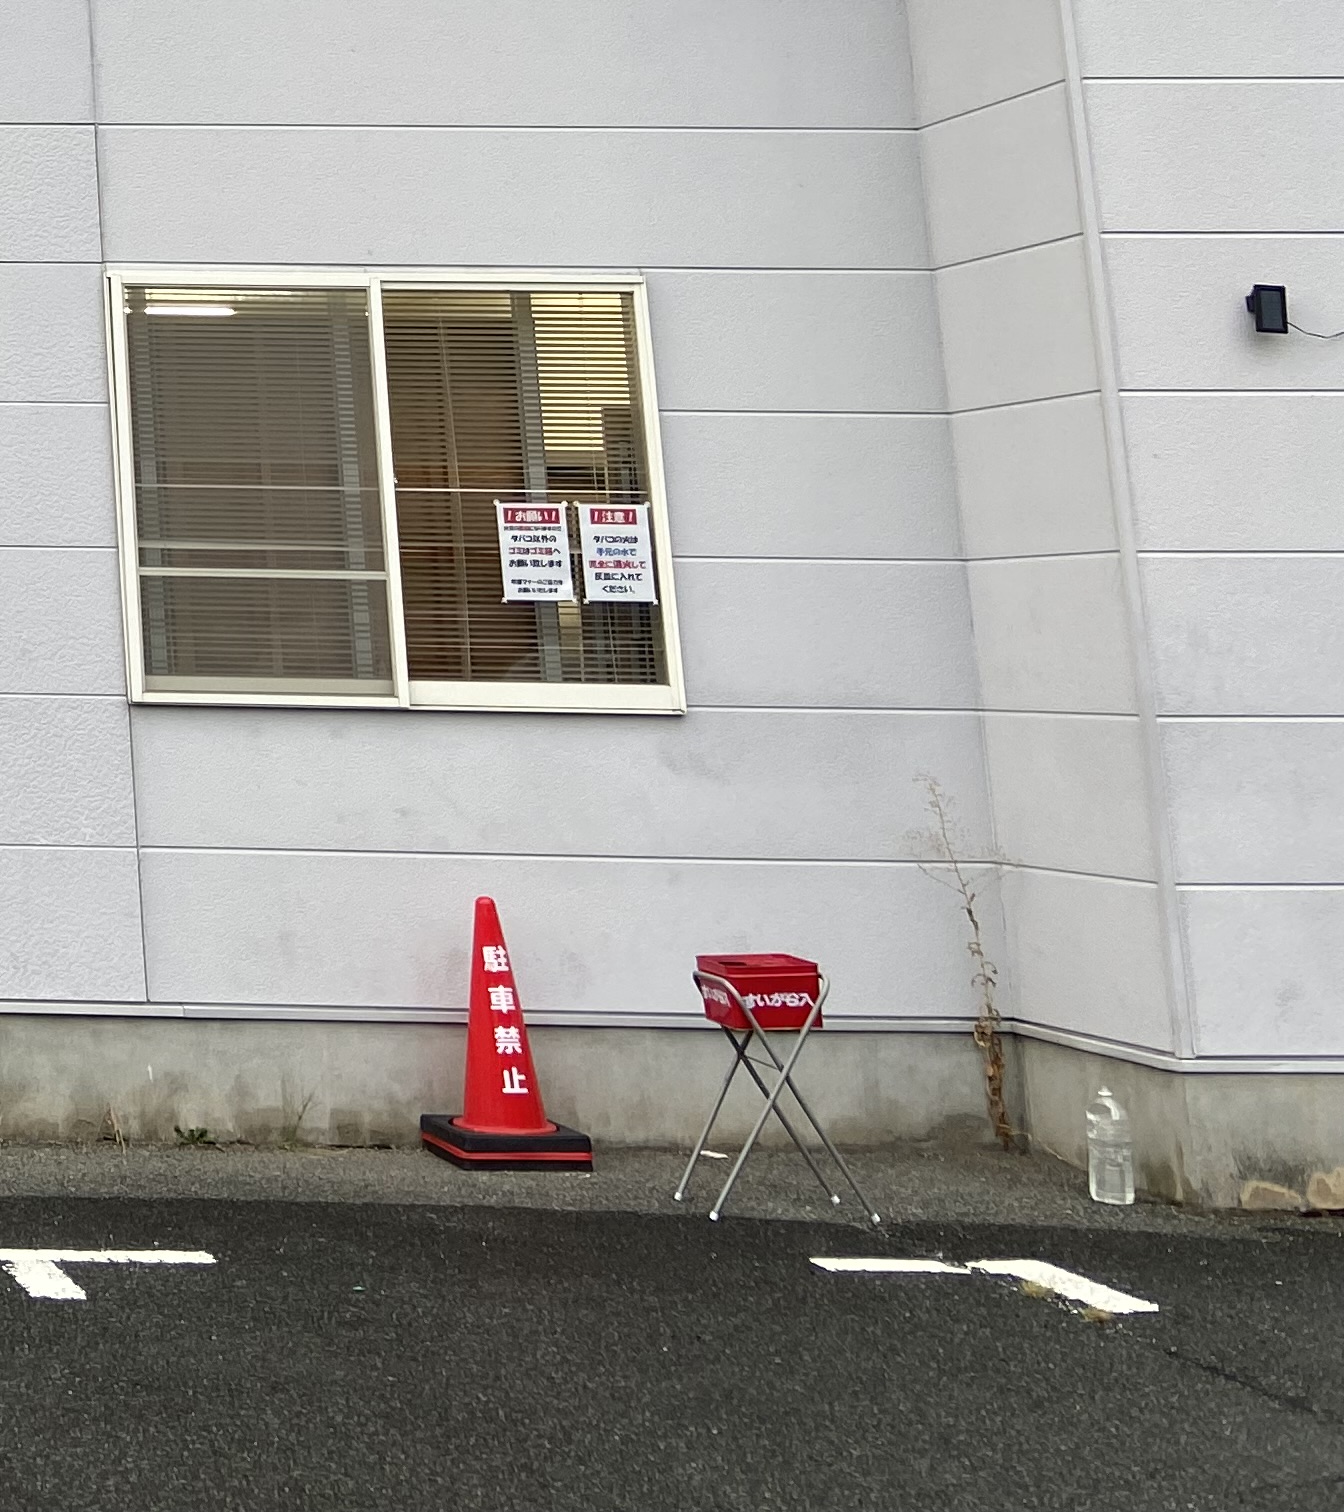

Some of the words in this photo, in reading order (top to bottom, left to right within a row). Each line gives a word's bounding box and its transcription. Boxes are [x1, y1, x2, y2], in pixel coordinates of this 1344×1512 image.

[510, 534, 557, 543] タバコ以外の
[593, 535, 639, 544] タバコの火は
[481, 945, 529, 1094] 駐車禁止
